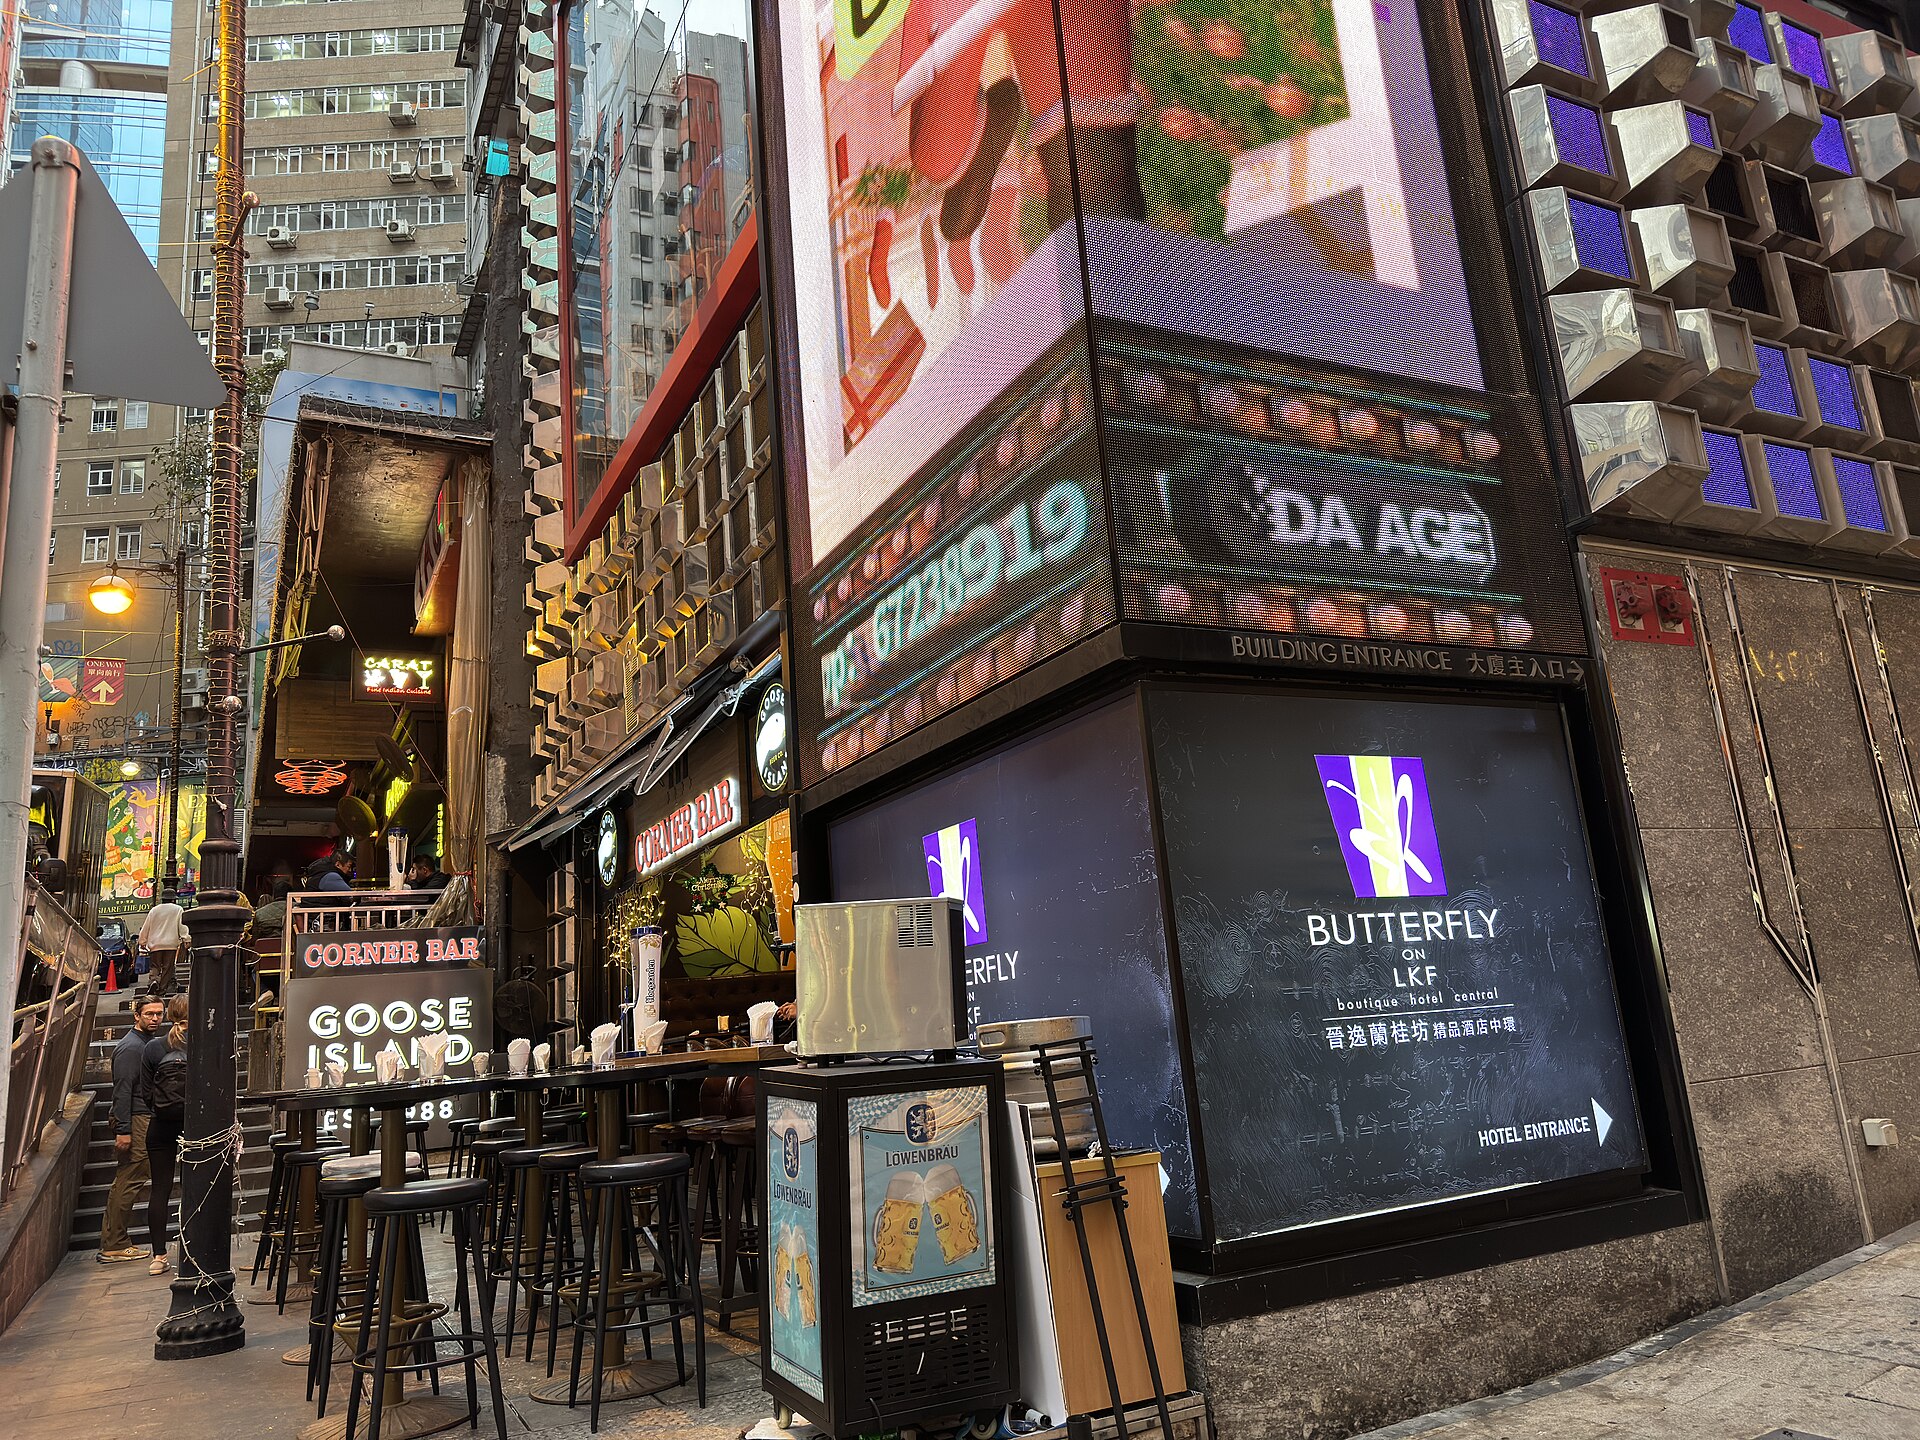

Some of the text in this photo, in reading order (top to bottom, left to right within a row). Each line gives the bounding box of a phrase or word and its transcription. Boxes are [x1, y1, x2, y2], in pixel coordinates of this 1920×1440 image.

[1375, 502, 1486, 567] AGE
[873, 479, 1090, 661] 67238919
[86, 660, 124, 669] ONE WAY
[364, 656, 433, 671] CARAT
[1231, 635, 1453, 672] BUILDING ENTRANCE
[1466, 652, 1565, 679] 大廈主入口
[760, 688, 785, 721] GOOSE
[763, 751, 788, 785] ISLAN
[635, 779, 734, 873] CORNER BAR
[98, 906, 121, 914] SHARE
[137, 903, 151, 912] JOY
[1307, 909, 1498, 946] BUTTERFLY
[304, 937, 481, 967] CORNER BAR
[1401, 949, 1426, 960] ON
[1393, 965, 1437, 987] LKF
[1337, 987, 1499, 1011] boutique hotel central
[308, 996, 473, 1040] GOOSE
[1325, 1016, 1517, 1050] 晉逸蘭桂坊 精品酒店中環
[1478, 1116, 1591, 1147] HOTEL ENTRANCE
[886, 1145, 959, 1168] LÖWENBRÄU
[773, 1178, 812, 1210] LÖWENBRÄU
